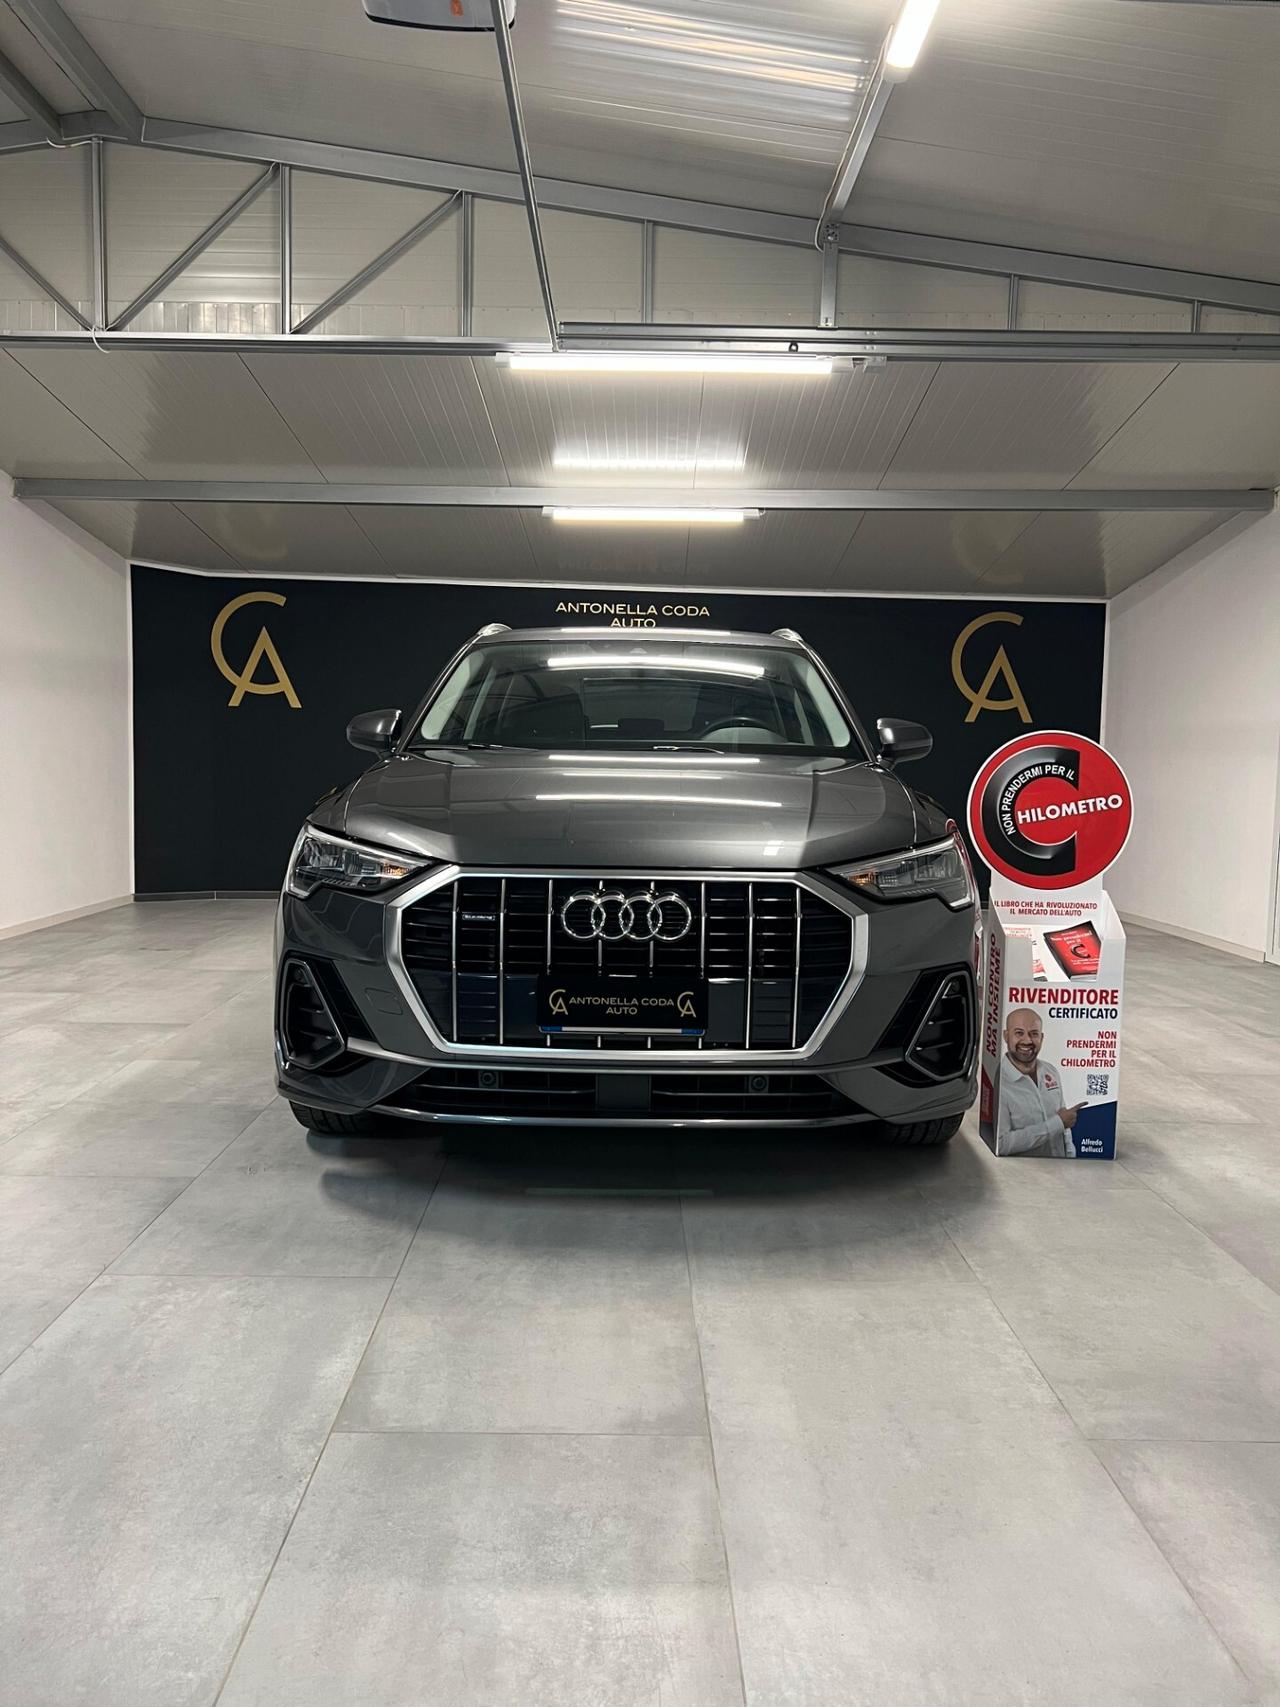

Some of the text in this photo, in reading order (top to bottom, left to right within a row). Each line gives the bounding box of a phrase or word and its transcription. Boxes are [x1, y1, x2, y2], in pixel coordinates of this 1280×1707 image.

[555, 602, 710, 617] ANTONELLA CODA
[610, 617, 656, 628] AUTO
[1001, 765, 1075, 835] NON PRENDERMI PER IL
[1046, 901, 1098, 910] RIVOLUZIONATO
[986, 933, 996, 1053] NON CONTRO
[1008, 987, 1119, 1005] RIVENDITORE
[569, 996, 674, 1007] ANTONELLA CODA
[991, 946, 1001, 1058] MA INSIEME
[606, 1006, 638, 1015] AUTO
[1048, 1007, 1118, 1019] CERTIFICATO
[1097, 1031, 1117, 1040] NON
[1066, 1040, 1117, 1049] PRENDERMI
[1091, 1050, 1116, 1058] PER IL
[1060, 1059, 1116, 1067] CHILOMETRO
[1081, 1138, 1102, 1146] Alfredo
